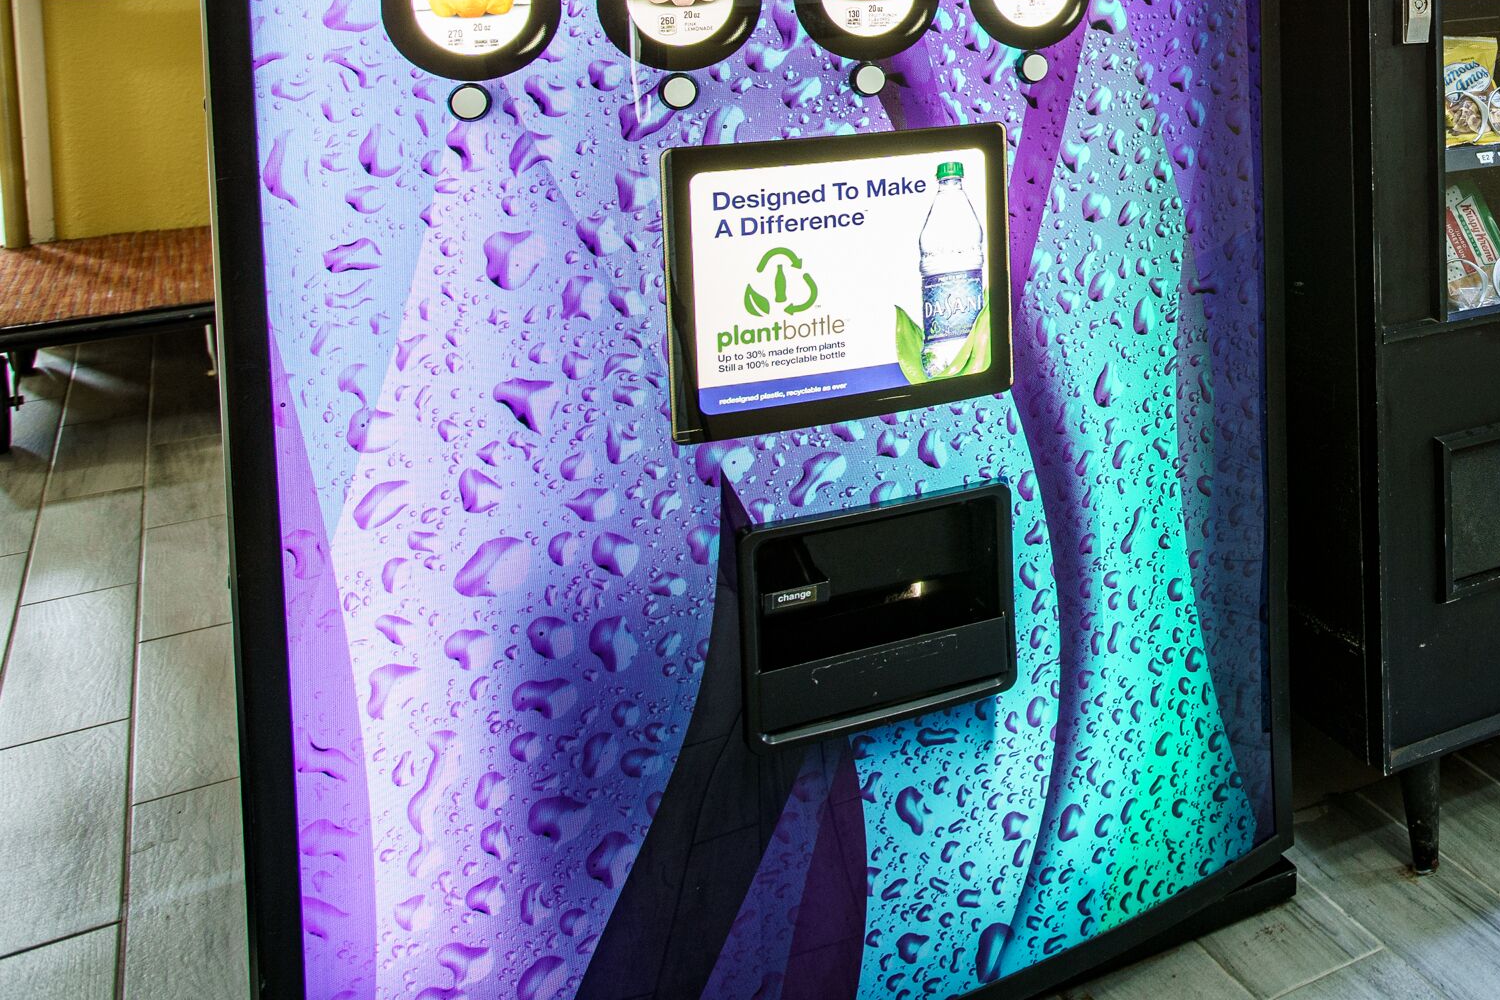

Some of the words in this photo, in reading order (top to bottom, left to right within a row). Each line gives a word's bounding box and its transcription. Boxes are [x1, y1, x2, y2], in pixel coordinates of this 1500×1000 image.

[660, 16, 675, 25] 260
[684, 11, 692, 19] 20
[868, 4, 876, 12] 20
[448, 30, 463, 38] 270
[473, 23, 482, 31] 20
[1456, 68, 1489, 92] Amos
[712, 184, 826, 212] Designed
[832, 182, 859, 200] To
[866, 177, 926, 198] Make
[714, 220, 734, 239] A
[740, 210, 865, 236] Difference
[1460, 203, 1481, 235] Krispy
[1475, 231, 1494, 263] Kreme
[1446, 223, 1459, 244] HONEY
[1456, 244, 1466, 259] BUN
[1454, 229, 1467, 249] JUMBO
[924, 294, 982, 320] DASANI
[717, 314, 845, 353] plantbottle
[718, 354, 732, 363] Up
[746, 350, 766, 360] 30%
[768, 347, 794, 356] made
[796, 345, 816, 353] from
[818, 341, 846, 352] plants
[718, 364, 736, 372] Still
[747, 360, 769, 370] 100%
[771, 353, 817, 367] recyclable
[820, 351, 846, 360] bottle
[719, 393, 759, 405] redesigned
[760, 390, 785, 401] plastic,
[786, 385, 821, 396] recyclable
[777, 589, 812, 604] change
